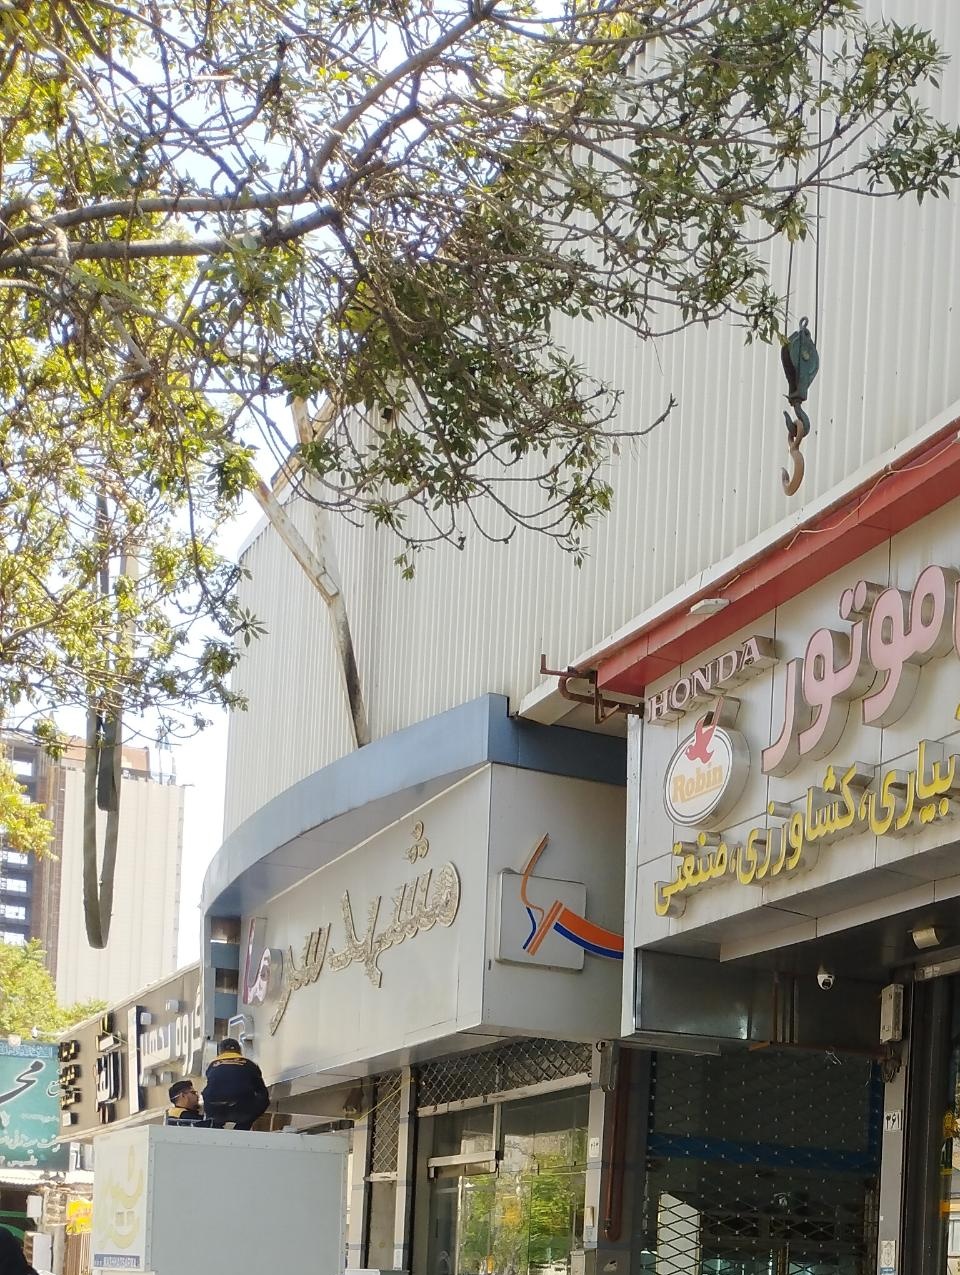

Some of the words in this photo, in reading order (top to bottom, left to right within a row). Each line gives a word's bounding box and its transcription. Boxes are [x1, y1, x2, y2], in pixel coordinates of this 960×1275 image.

[648, 636, 761, 722] HONDA
[761, 565, 949, 773] موتور
[671, 763, 725, 804] Robin
[327, 820, 462, 989] مشهد
[655, 831, 728, 916] صنعتی
